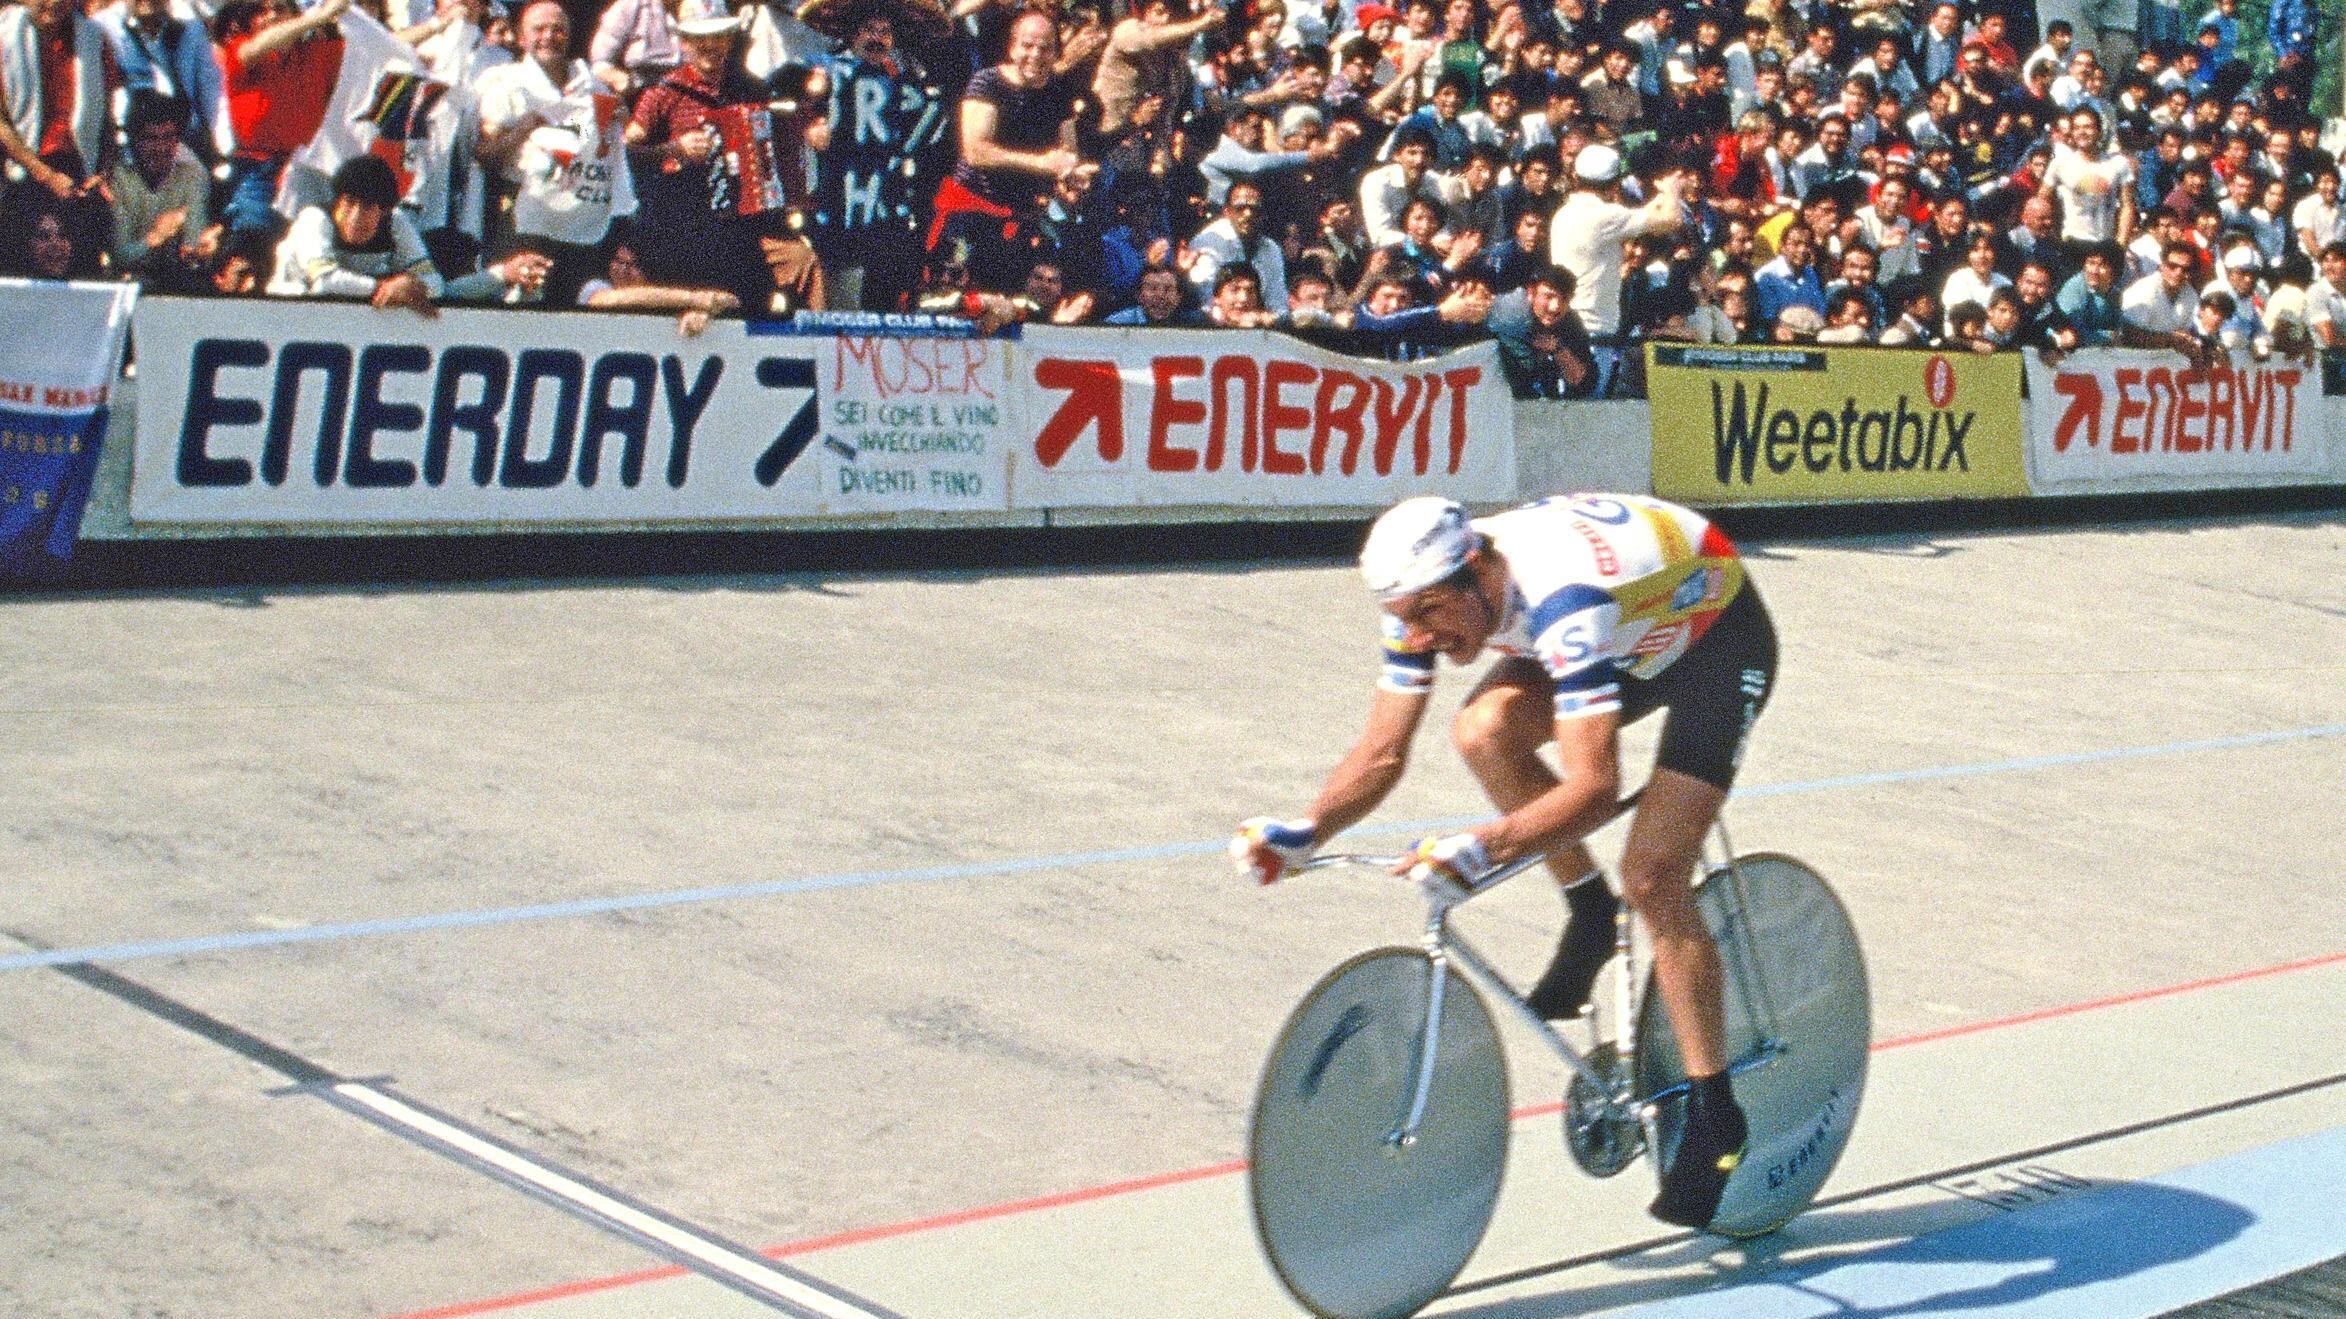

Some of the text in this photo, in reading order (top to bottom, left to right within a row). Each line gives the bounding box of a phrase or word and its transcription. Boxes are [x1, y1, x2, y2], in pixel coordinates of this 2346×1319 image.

[176, 338, 724, 488] ENERDAY
[834, 335, 995, 399] MOSER
[1148, 356, 1481, 476] ENERVIT
[2110, 366, 2301, 454] ENERVIT
[1712, 378, 1976, 486] Weetabix
